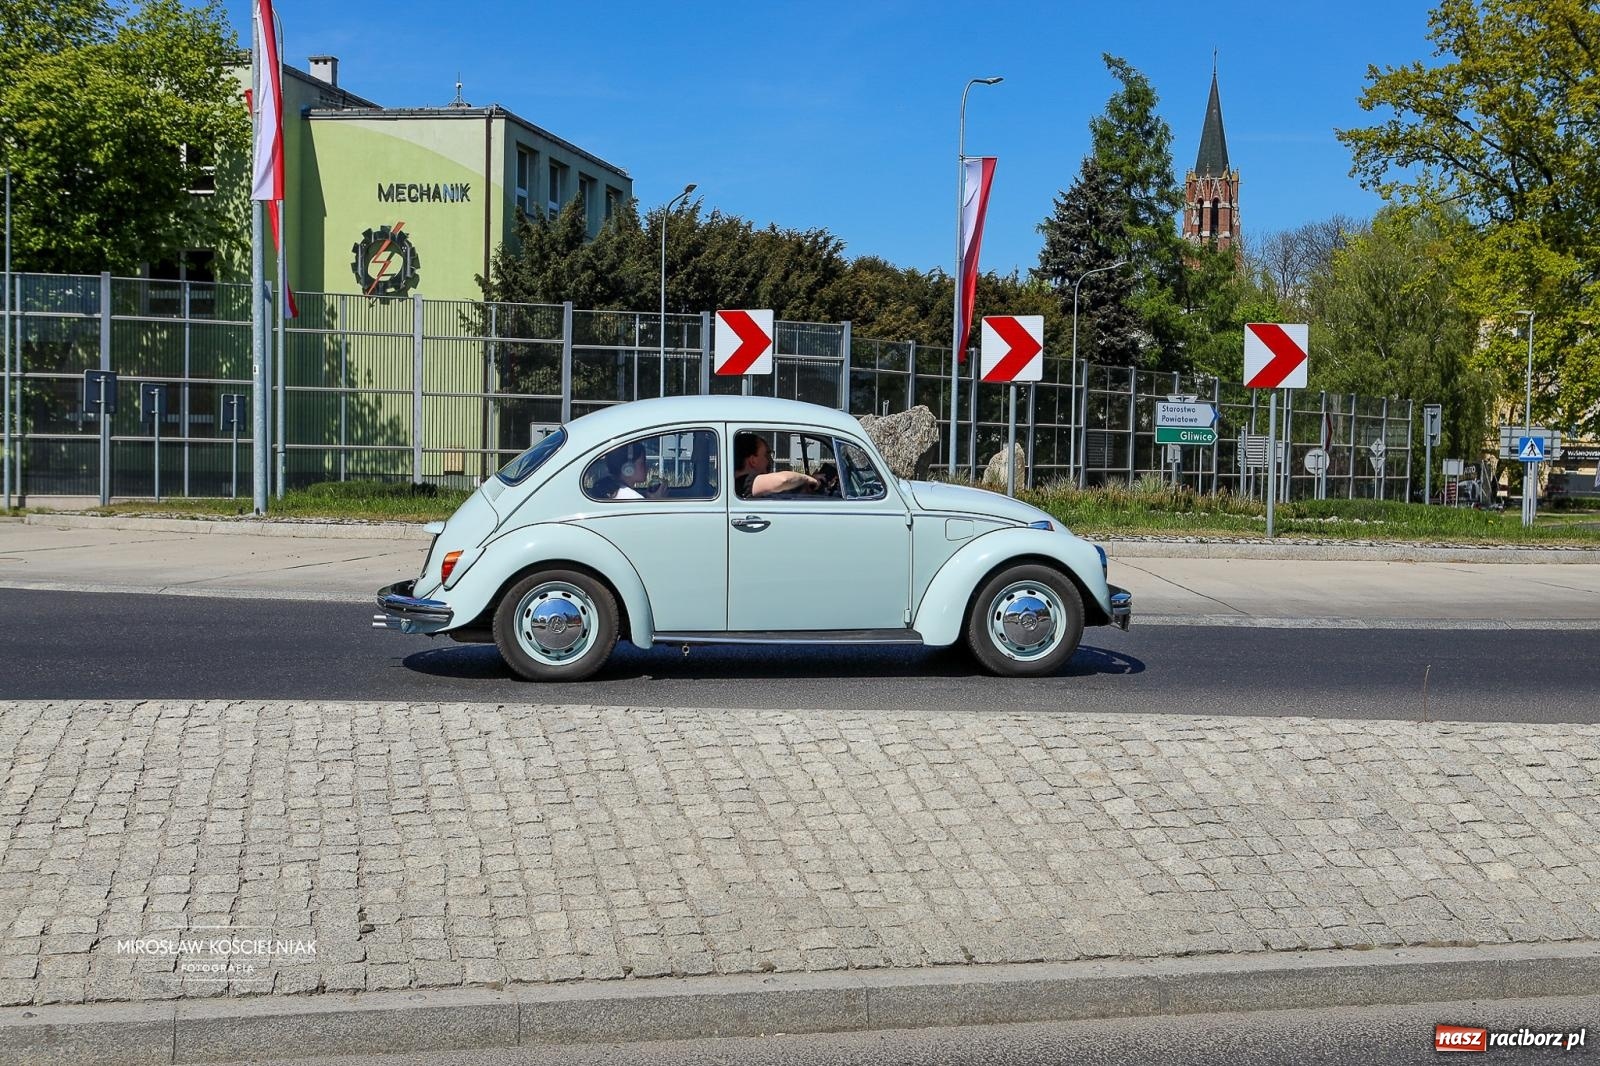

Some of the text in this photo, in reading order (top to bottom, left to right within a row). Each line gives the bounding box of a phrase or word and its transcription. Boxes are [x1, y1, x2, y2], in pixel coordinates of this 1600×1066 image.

[377, 182, 471, 203] MECHANIK
[1162, 404, 1196, 414] Starostwo
[1161, 414, 1198, 424] Powiatowe
[1180, 431, 1213, 441] Gliwice
